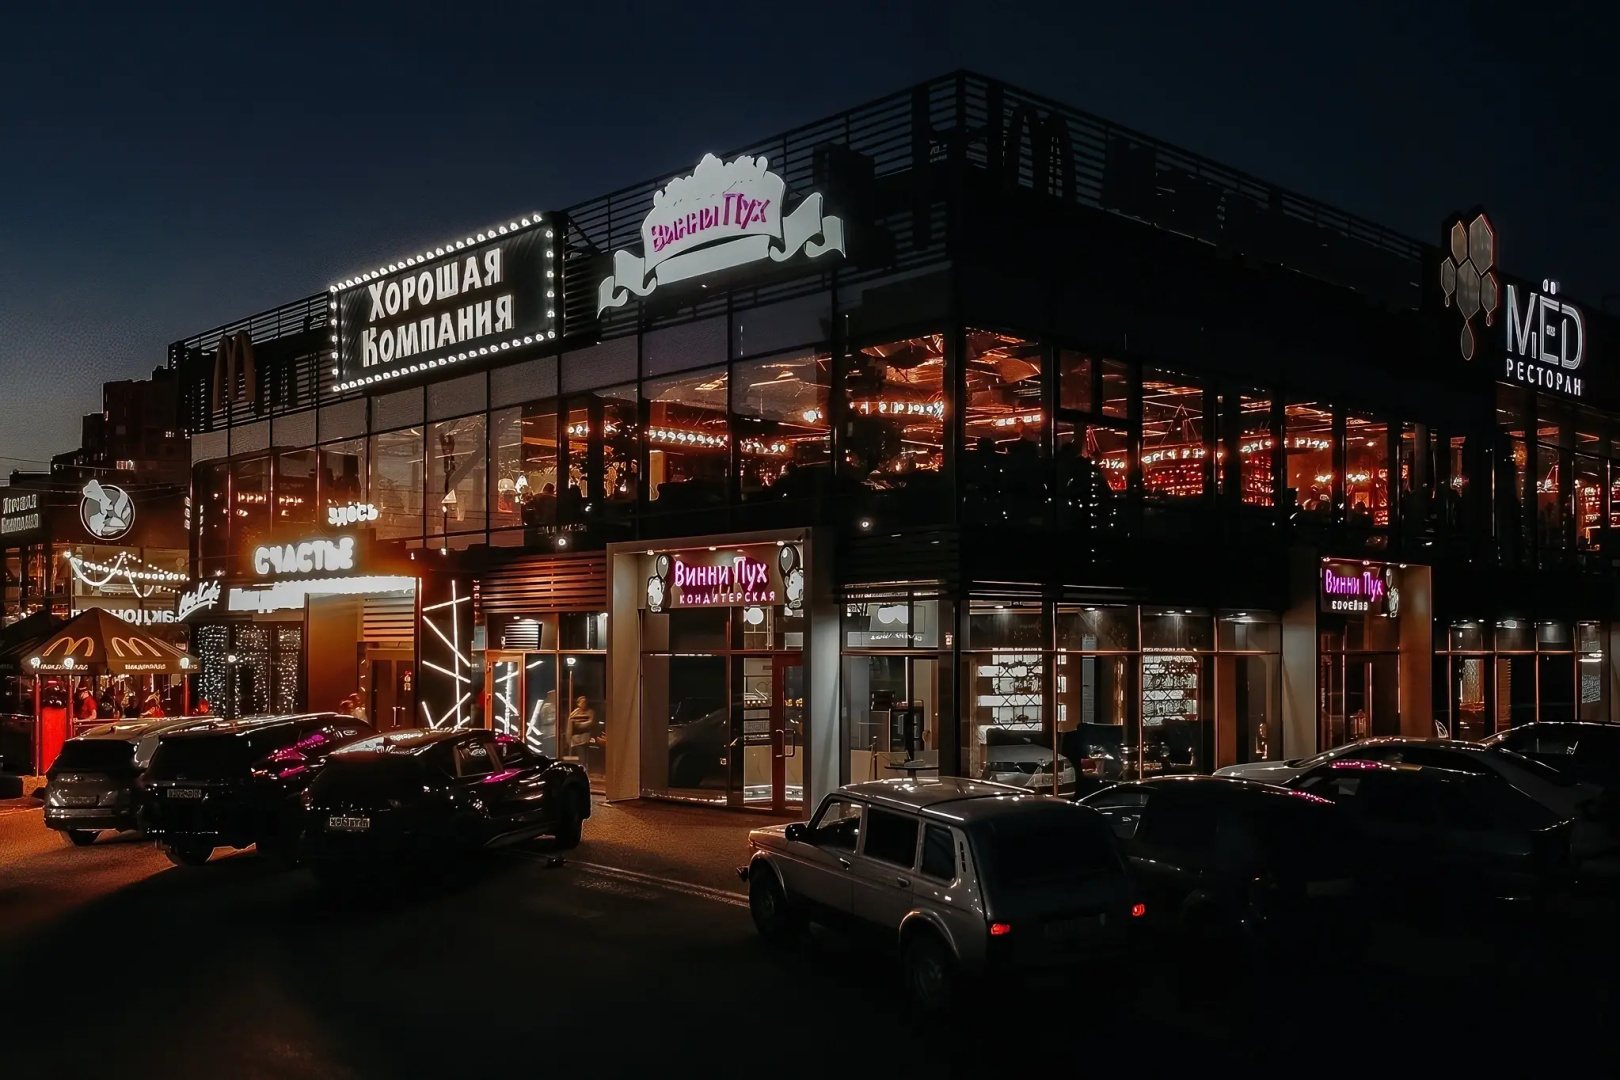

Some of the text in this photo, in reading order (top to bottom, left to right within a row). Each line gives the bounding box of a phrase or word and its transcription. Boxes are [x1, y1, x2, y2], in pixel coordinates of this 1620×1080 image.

[1506, 358, 1581, 397] РЕСТОРАН
[254, 537, 354, 575] СЧАСТЬЕ
[674, 556, 768, 591] Винни Пух
[679, 590, 776, 605] КОНДИТЕРСКАЯ
[1325, 568, 1360, 595] Винни
